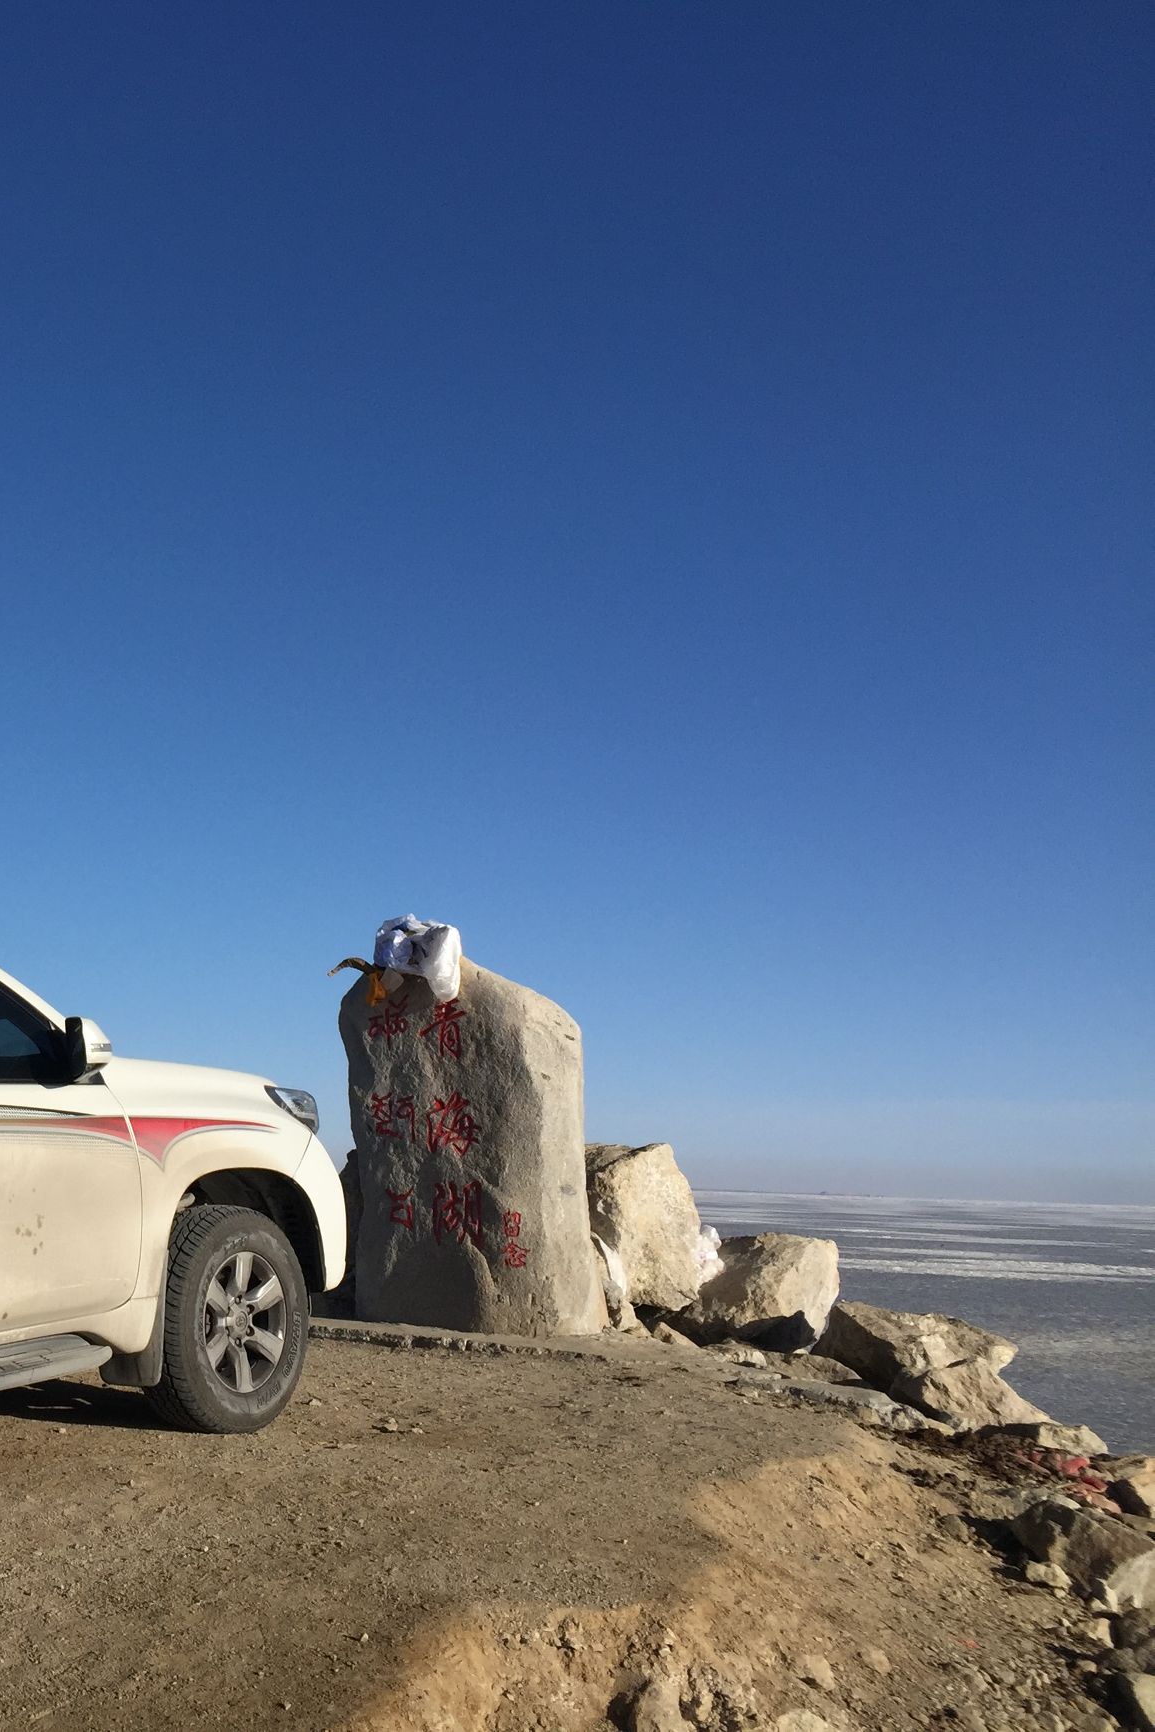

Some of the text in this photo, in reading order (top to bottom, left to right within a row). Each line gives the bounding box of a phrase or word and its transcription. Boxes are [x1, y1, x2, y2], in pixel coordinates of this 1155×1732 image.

[418, 998, 486, 1251] 青海湖
[502, 1208, 531, 1268] 留念
